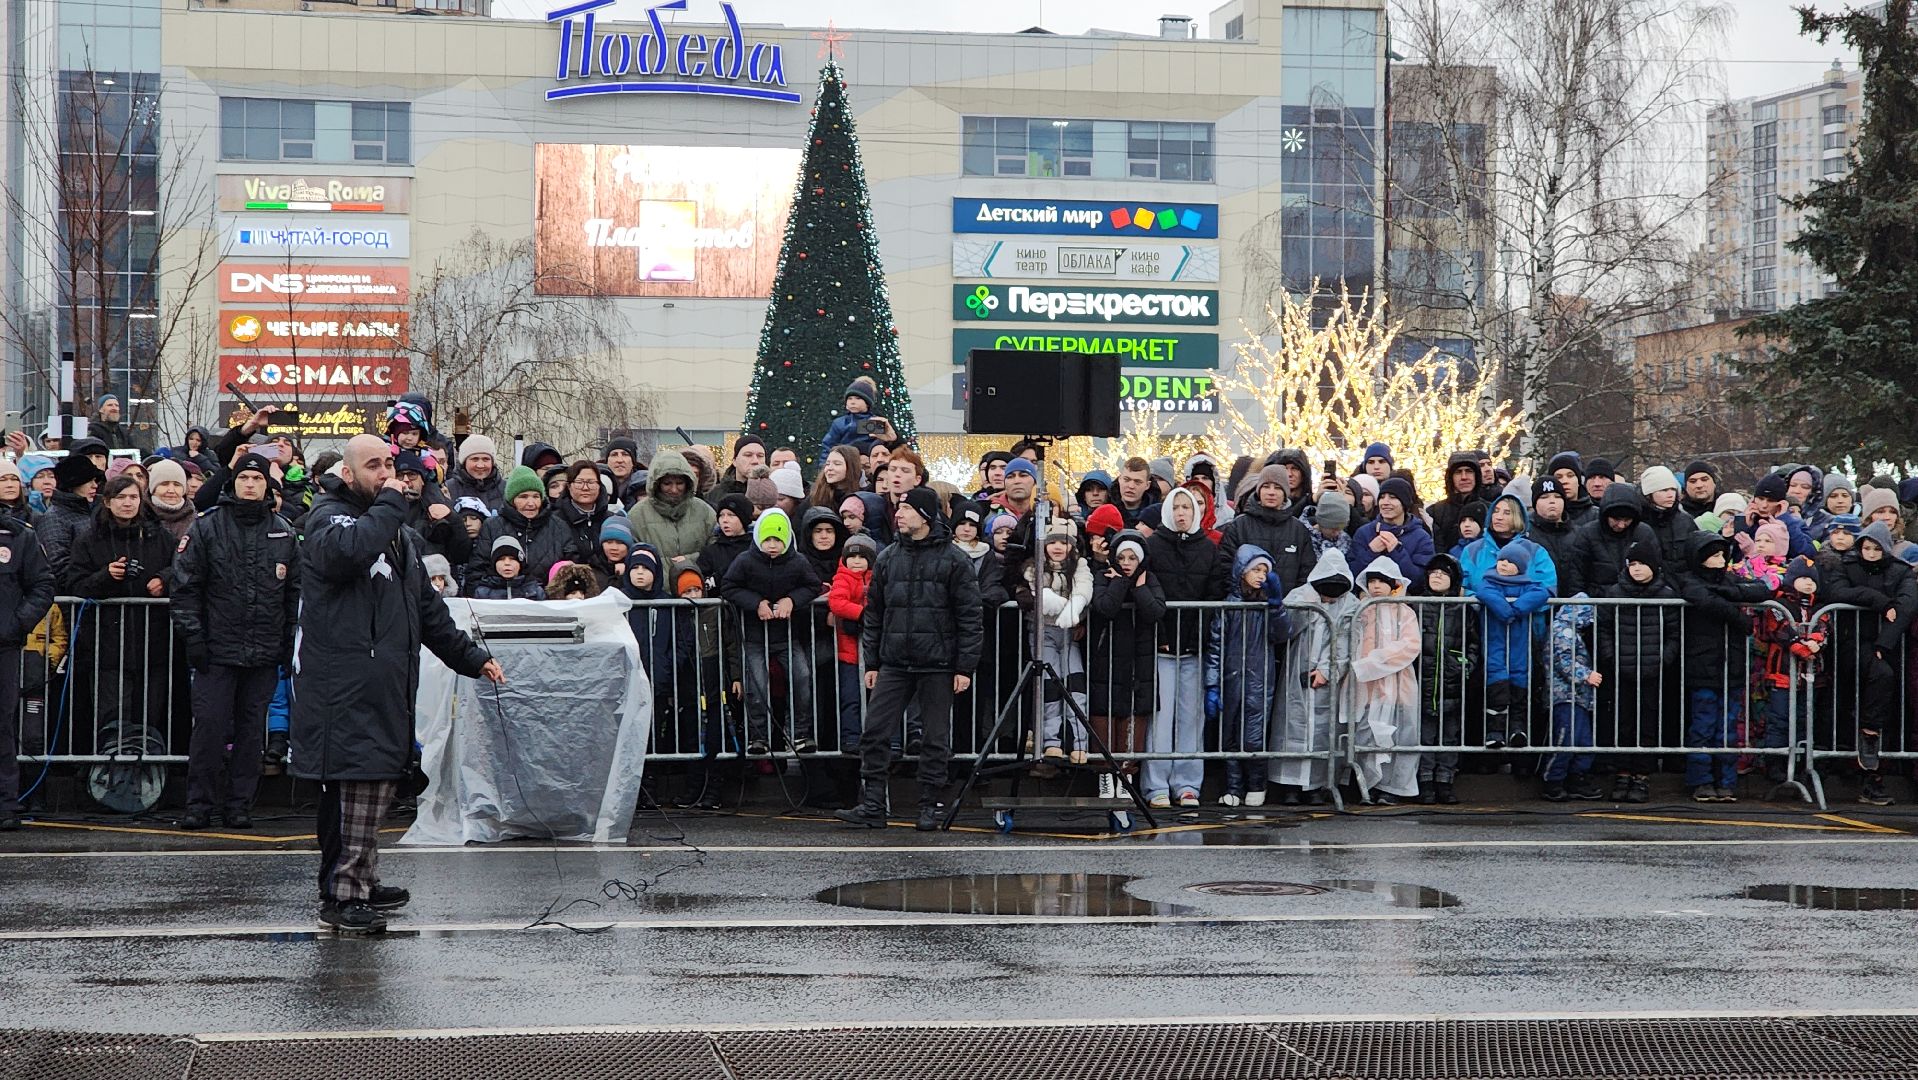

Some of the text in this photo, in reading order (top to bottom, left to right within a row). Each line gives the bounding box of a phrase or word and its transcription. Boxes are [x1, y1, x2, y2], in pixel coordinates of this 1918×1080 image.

[244, 178, 385, 202] Viva Roma
[976, 203, 1103, 229] Детский мир
[270, 227, 389, 248] ЧИТАЙ-ГОРОД
[1016, 262, 1048, 275] театр
[1062, 253, 1112, 269] ОБЛАКА
[1131, 262, 1160, 276] кафе
[231, 272, 304, 293] DNS
[1008, 286, 1211, 321] Перекресток
[266, 321, 400, 337] ЧЕТЫРЕ ЛАПЫ
[995, 336, 1178, 361] СУПЕРМАРКЕТ
[236, 363, 392, 386] ХОЗМАКС
